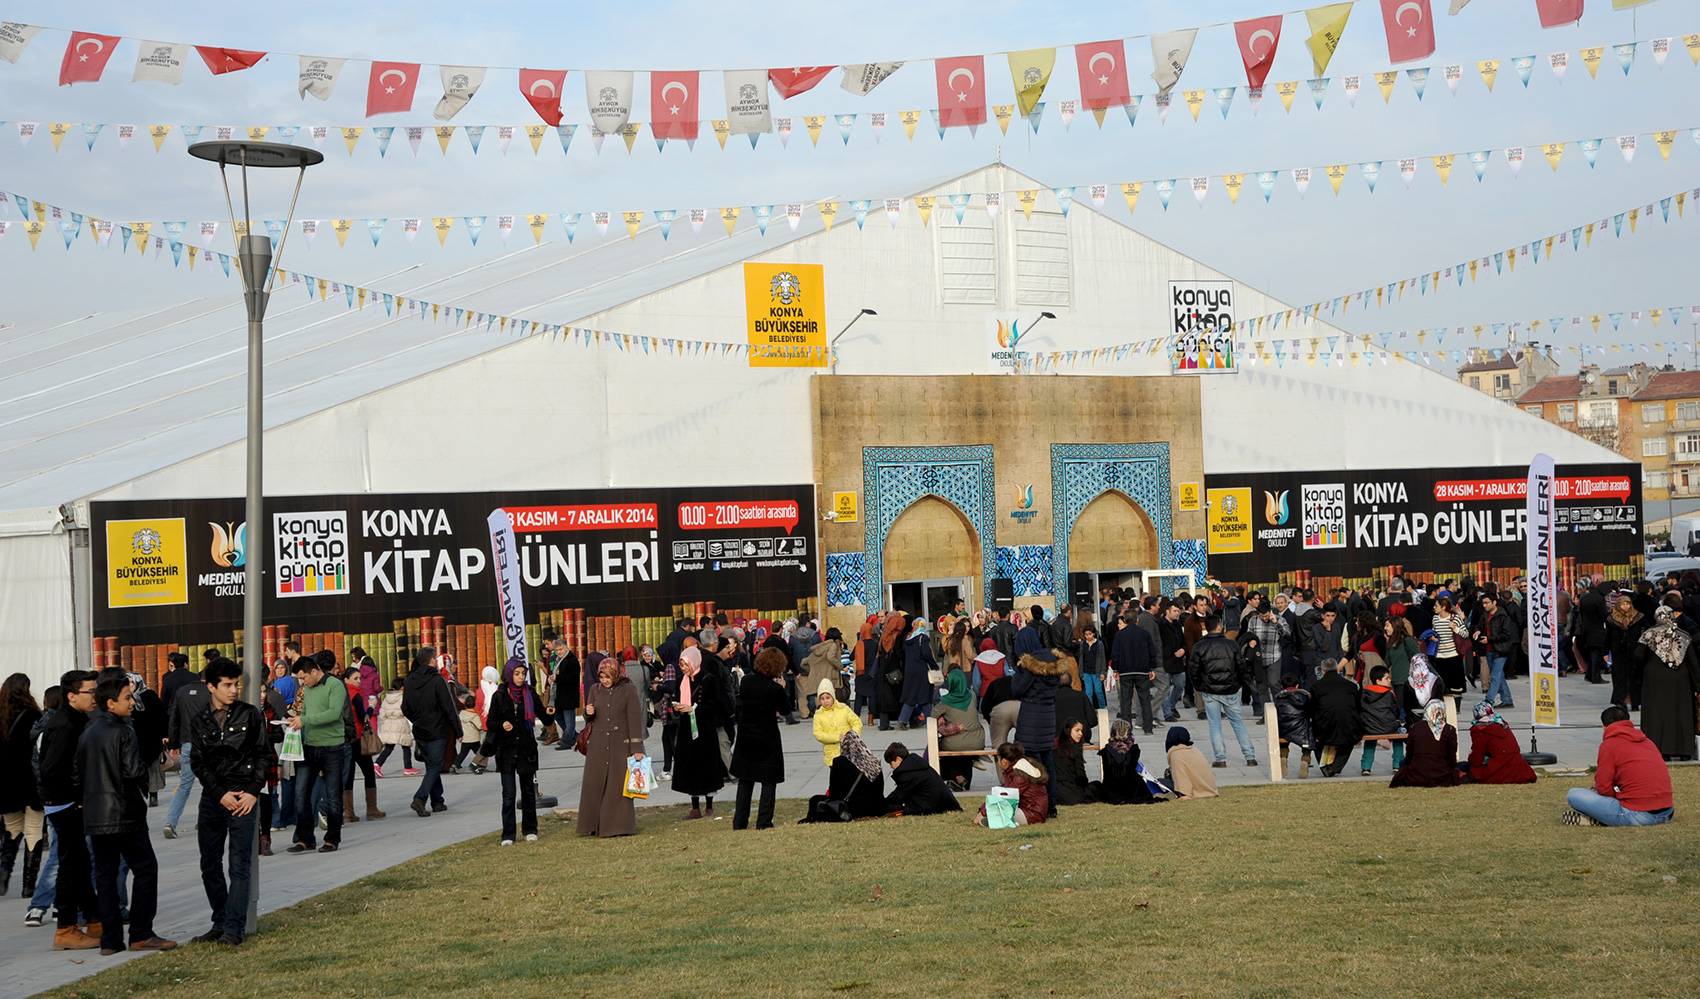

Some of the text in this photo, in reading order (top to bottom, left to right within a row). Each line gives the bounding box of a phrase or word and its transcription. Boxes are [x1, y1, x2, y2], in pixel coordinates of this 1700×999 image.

[1173, 285, 1231, 312] konya
[769, 307, 804, 318] KONYA
[755, 317, 818, 335] BÜYÜKŞEHİR
[769, 334, 807, 343] BELEDİYESİ
[1304, 488, 1343, 505] konya
[1353, 481, 1409, 505] KONYA
[1436, 486, 1447, 497] 28
[1447, 484, 1474, 497] KASIM
[1480, 485, 1486, 496] 7
[1487, 482, 1516, 496] ARALIK
[1554, 480, 1569, 496] 0.00
[1575, 479, 1592, 495] 21.00
[517, 510, 558, 527] KASIM
[568, 510, 576, 525] 7
[578, 508, 624, 526] ARALIK
[626, 507, 655, 525] 2014
[681, 505, 706, 526] 10.00
[715, 504, 740, 525] 21.00
[740, 504, 766, 520] saatleri
[767, 504, 797, 519] arasında
[1305, 503, 1344, 523] kitap
[278, 517, 344, 540] konya
[362, 508, 453, 538] KONYA
[1212, 522, 1248, 533] BÜYÜKŞEHİR
[1305, 521, 1344, 539] günleri
[1354, 505, 1429, 549] KİTAP
[1433, 502, 1528, 545] GÜNLER
[1535, 474, 1550, 588] GÜNLERİ
[1258, 528, 1297, 540] MEDENİYET
[1267, 538, 1288, 548] OKULU
[279, 536, 345, 562] kitap
[132, 555, 163, 566] KONYA
[364, 539, 486, 595] KİTAP
[517, 530, 660, 587] ÜNLERİ
[116, 565, 179, 580] BÜYÜKŞEHİR
[280, 559, 346, 583] günleri
[129, 578, 167, 587] BELEDİYESİ
